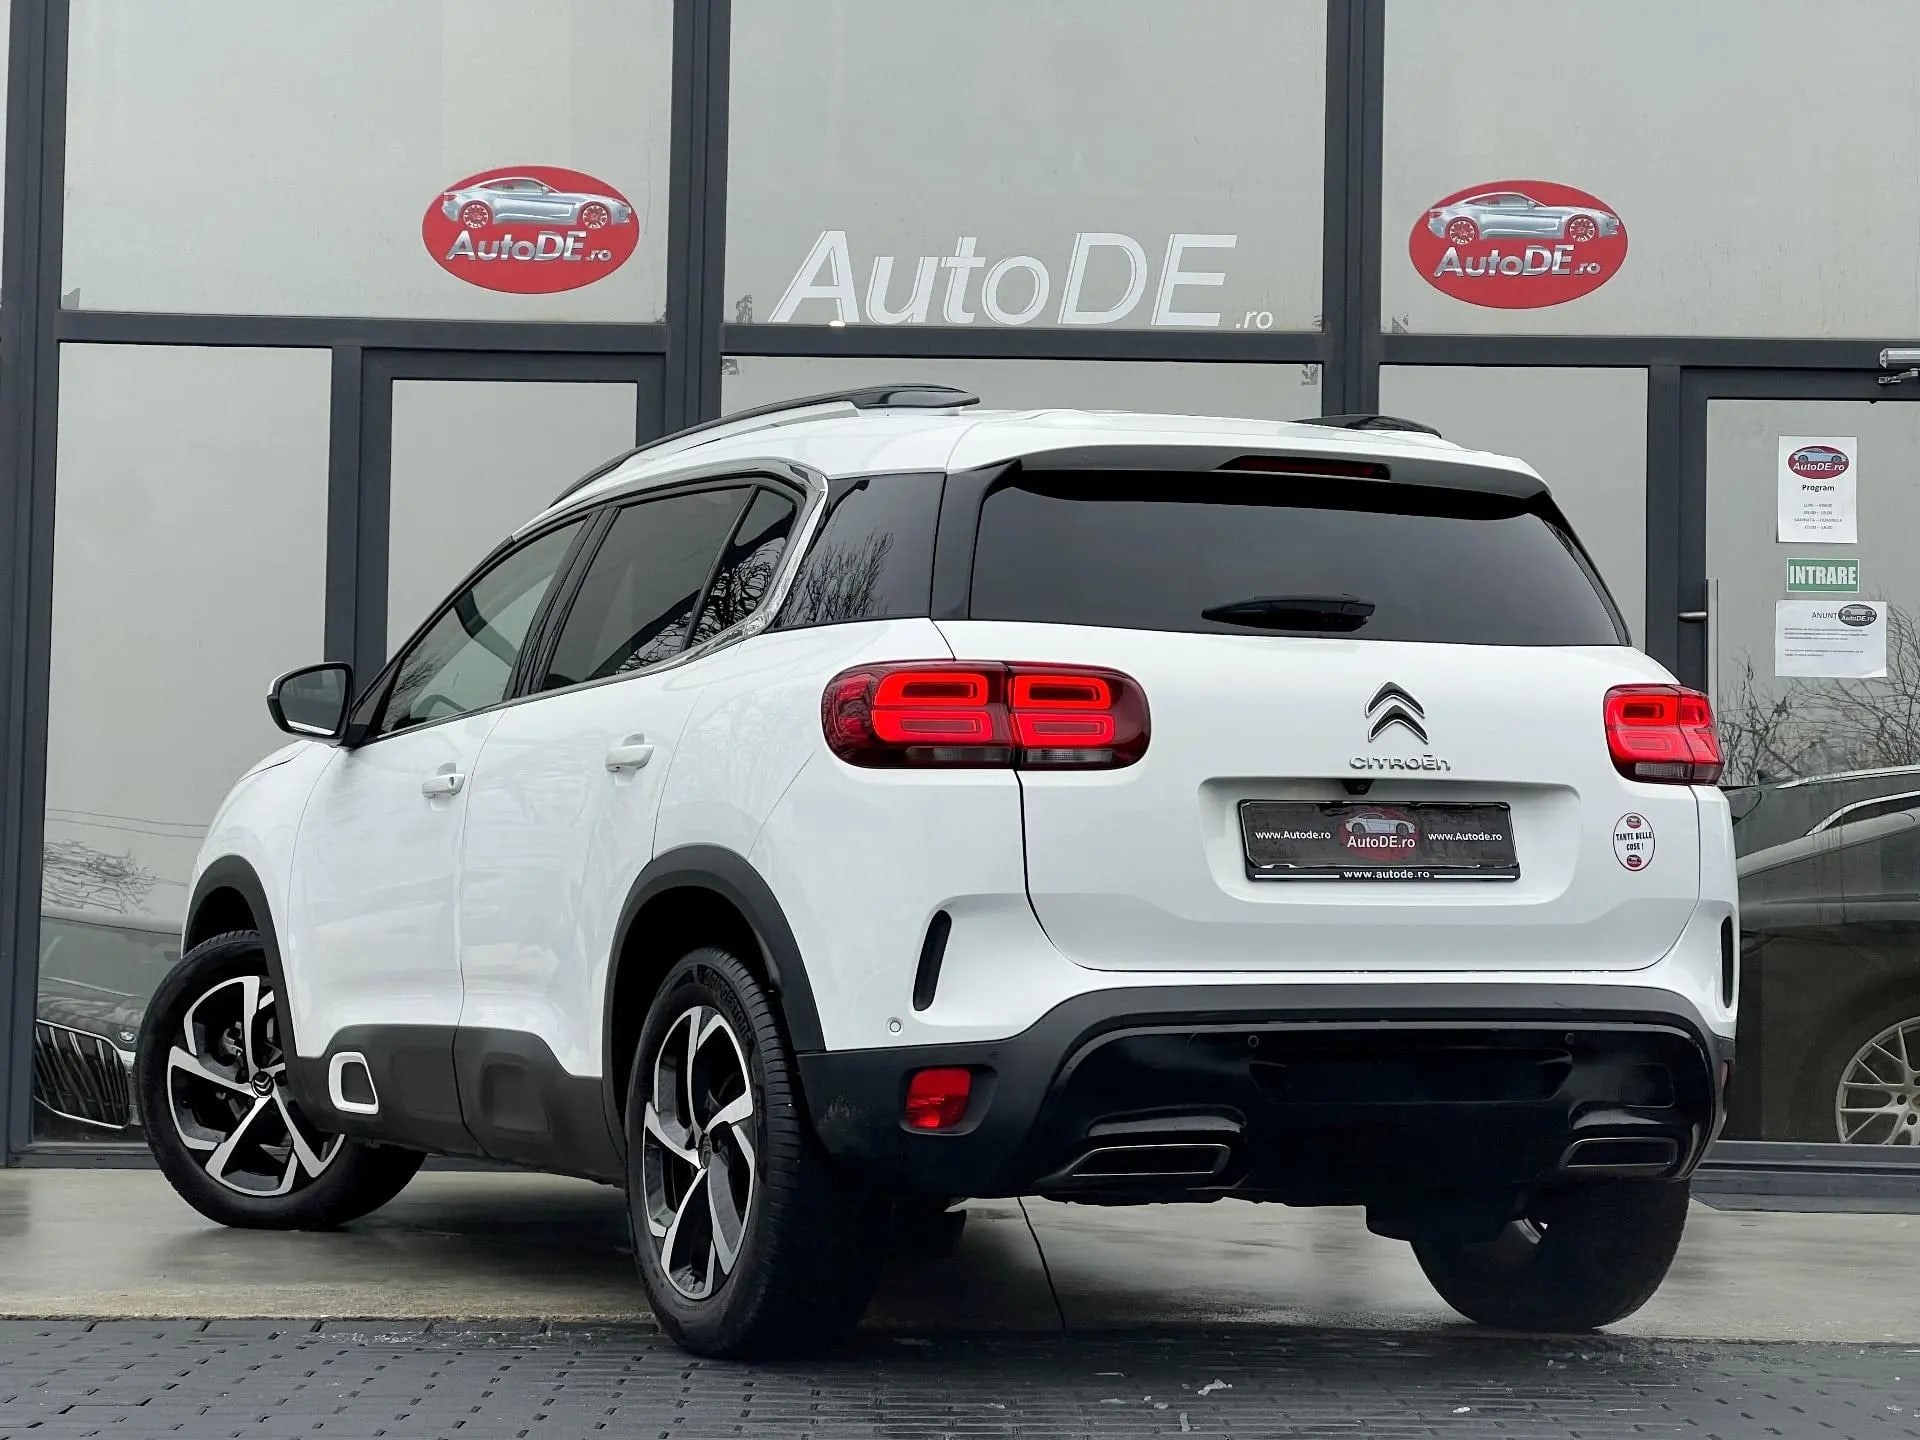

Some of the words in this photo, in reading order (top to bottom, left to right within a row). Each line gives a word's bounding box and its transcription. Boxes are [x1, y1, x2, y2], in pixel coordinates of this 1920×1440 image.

[1793, 462, 1845, 471] AutoDE.ro
[1802, 484, 1835, 492] Program
[1789, 565, 1856, 585] INTRARE
[1255, 830, 1331, 840] www.Autode.ro
[1427, 831, 1503, 842] www.Autode.ro
[1636, 832, 1652, 840] BELLE
[1346, 835, 1416, 849] AutoDE.ro
[1343, 869, 1430, 879] www.autode.ro
